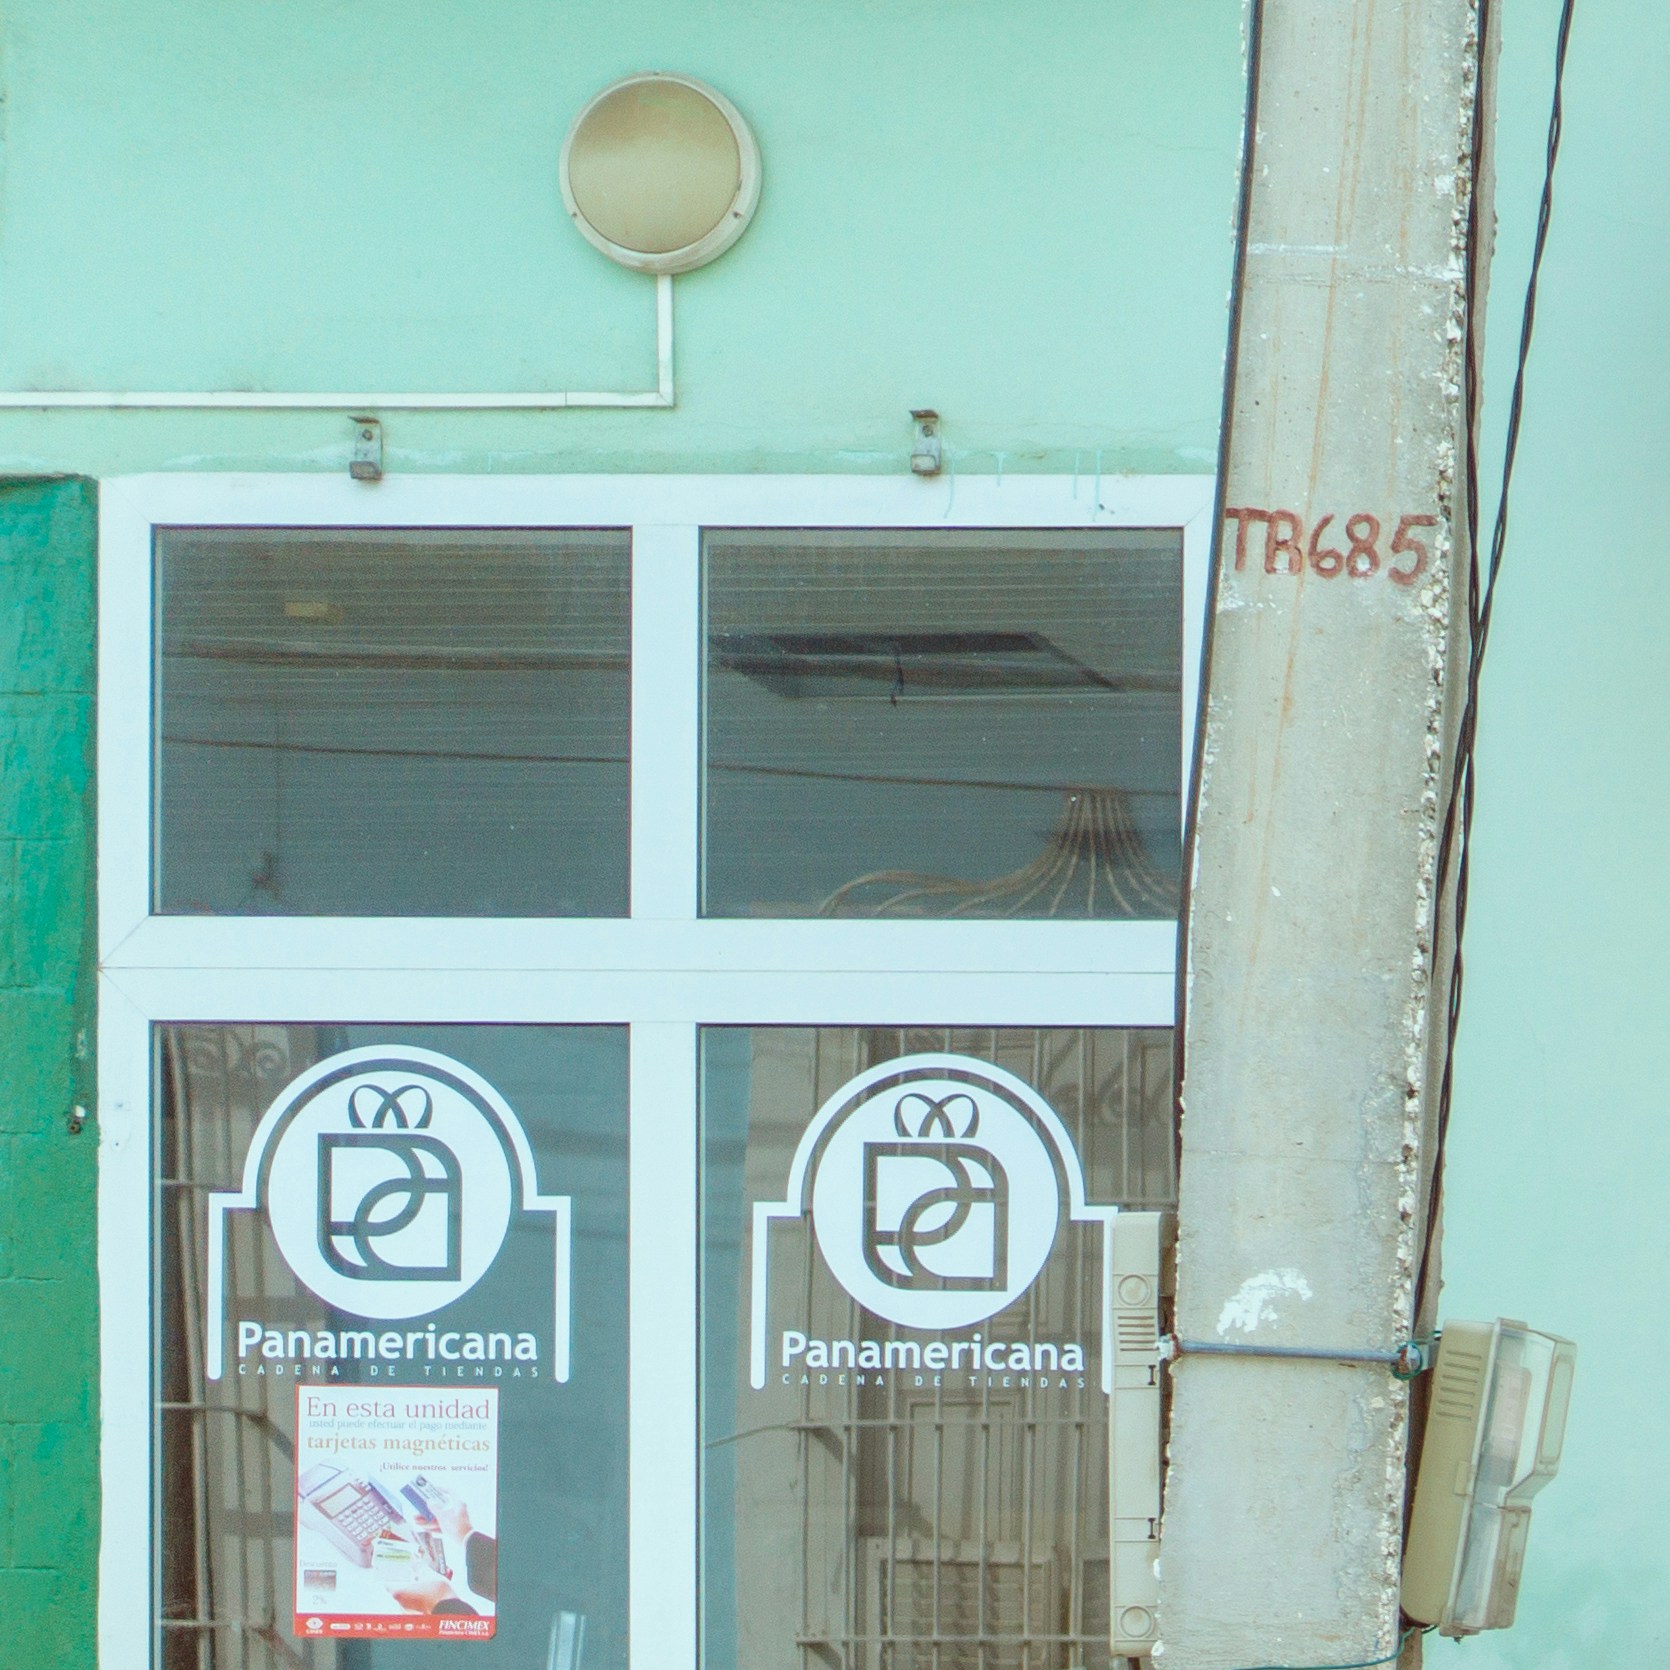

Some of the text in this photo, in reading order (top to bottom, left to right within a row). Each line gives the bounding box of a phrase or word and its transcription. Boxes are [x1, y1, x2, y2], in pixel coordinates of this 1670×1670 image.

[238, 1321, 538, 1361] Panamericana
[781, 1331, 1085, 1371] Panamericana
[238, 1365, 539, 1378] CADENA DE TIENDAS
[782, 1374, 1086, 1389] CADENA DE TIENDAS
[306, 1396, 490, 1420] En esta unidad
[306, 1433, 491, 1457] tarjetas magnéticas
